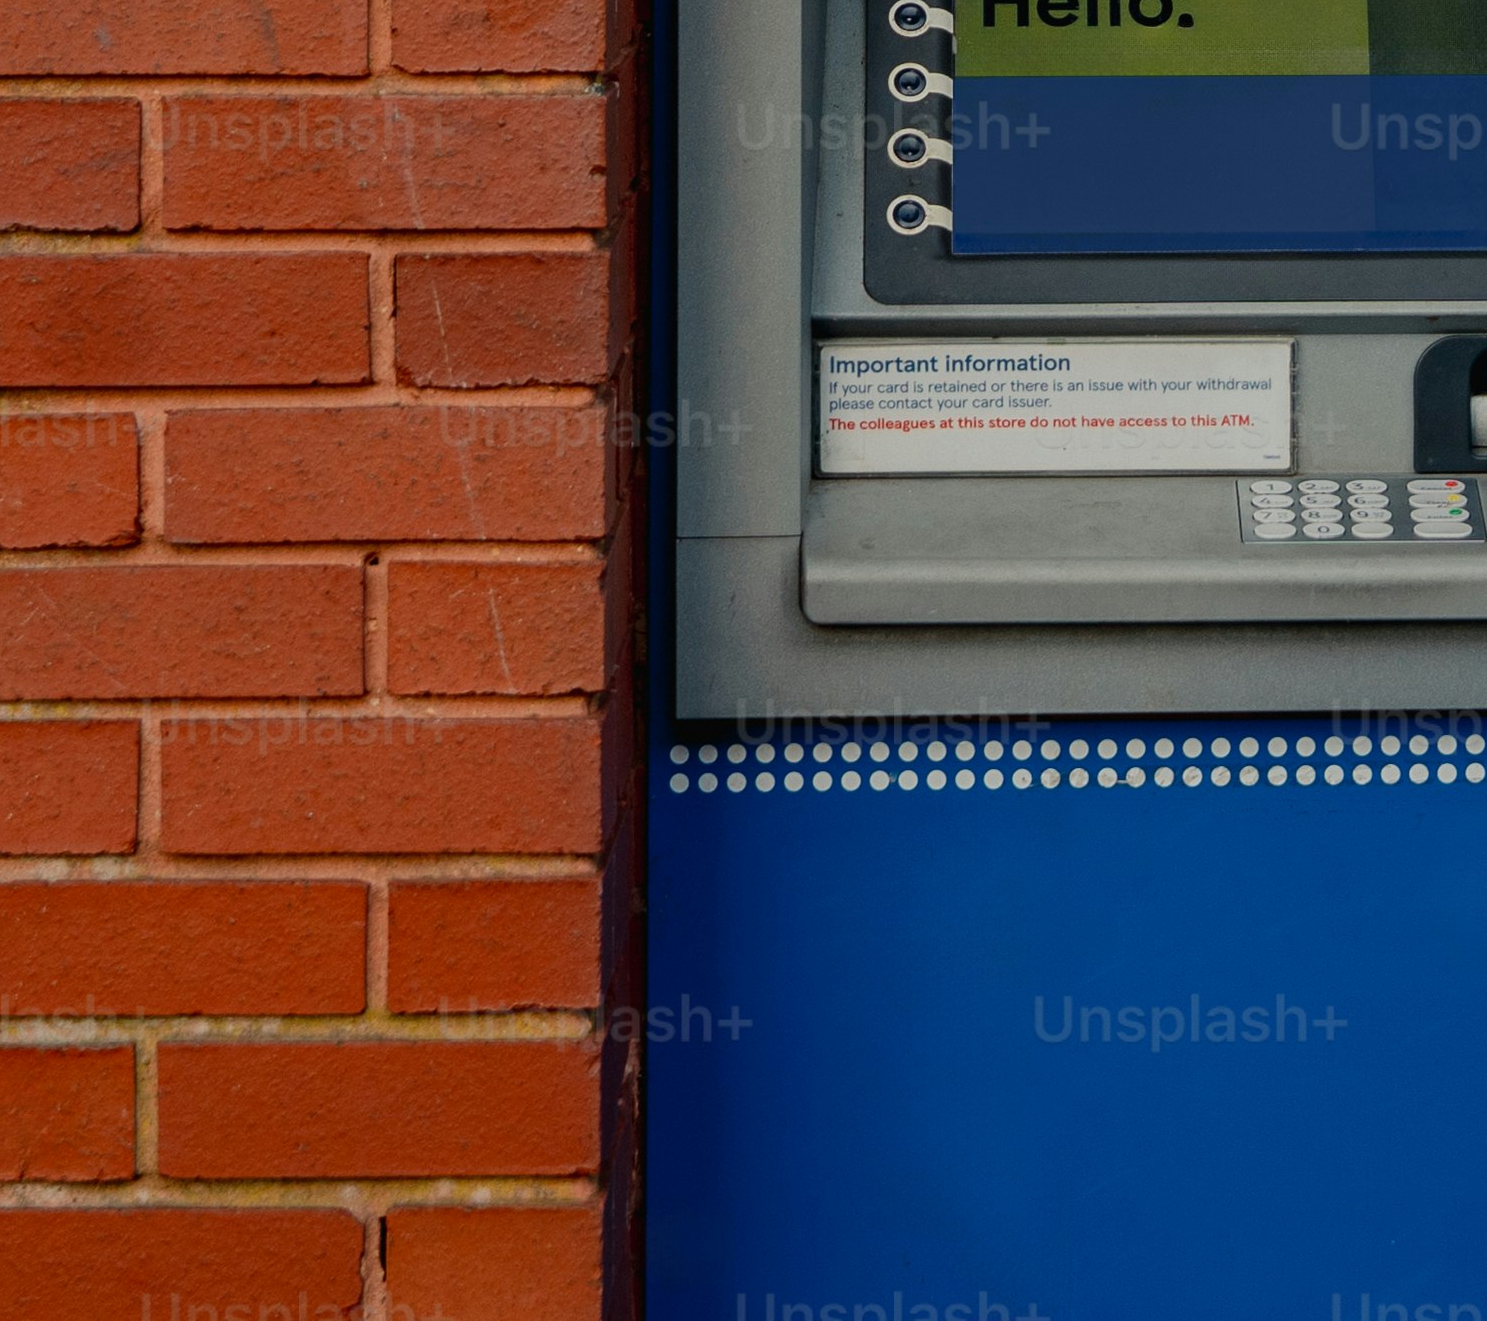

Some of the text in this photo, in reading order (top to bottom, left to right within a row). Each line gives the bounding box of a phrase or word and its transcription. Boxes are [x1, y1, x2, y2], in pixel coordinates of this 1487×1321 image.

[829, 354, 1070, 378] Important information
[829, 378, 1271, 397] If your card is retained or there is an issue with your withdrawal
[829, 396, 1052, 413] please contact your card issuer.
[829, 415, 1254, 432] The colleagues at this store do not have access to this ATM.
[1318, 525, 1330, 533] 0
